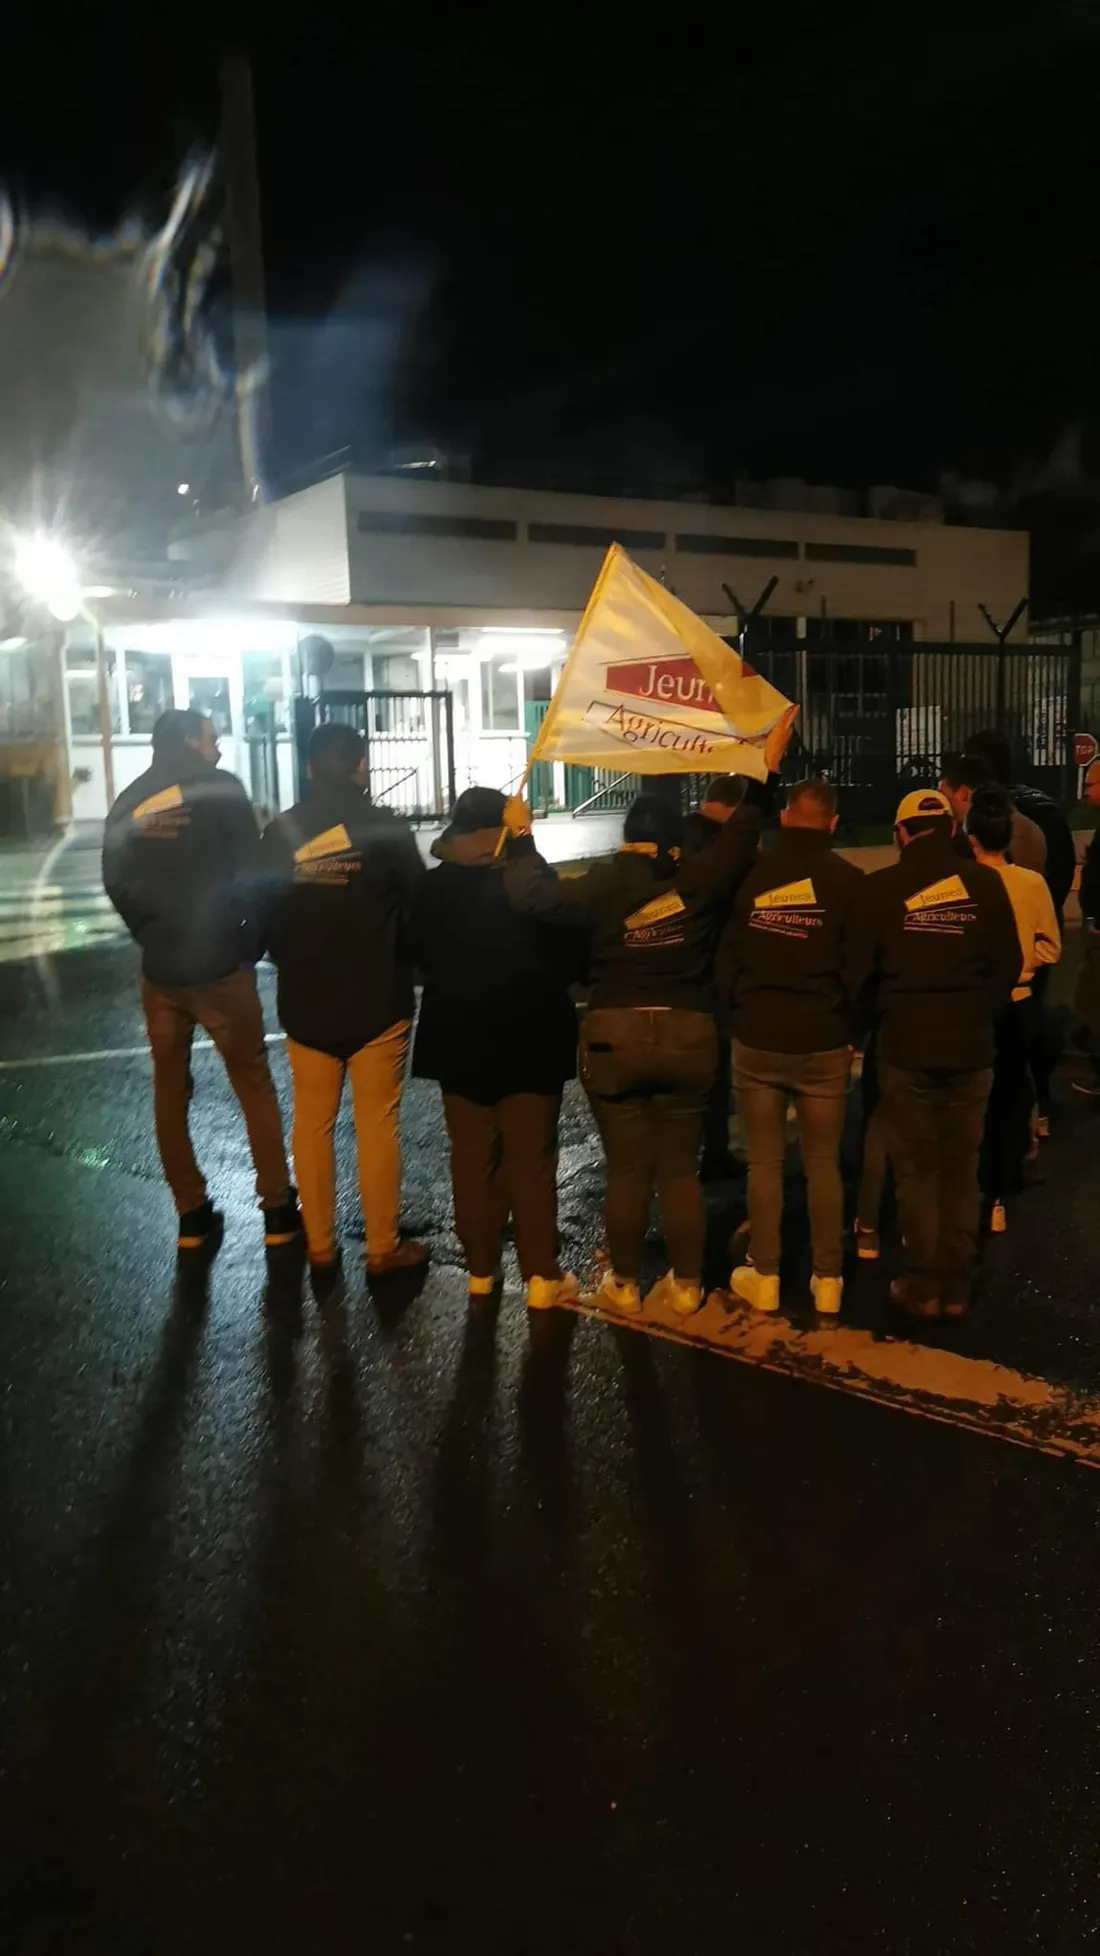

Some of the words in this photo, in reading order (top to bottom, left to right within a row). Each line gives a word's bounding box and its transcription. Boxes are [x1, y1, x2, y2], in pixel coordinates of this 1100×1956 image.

[639, 664, 713, 703] Jeun
[605, 703, 716, 754] Agricult
[1074, 744, 1094, 756] TOP
